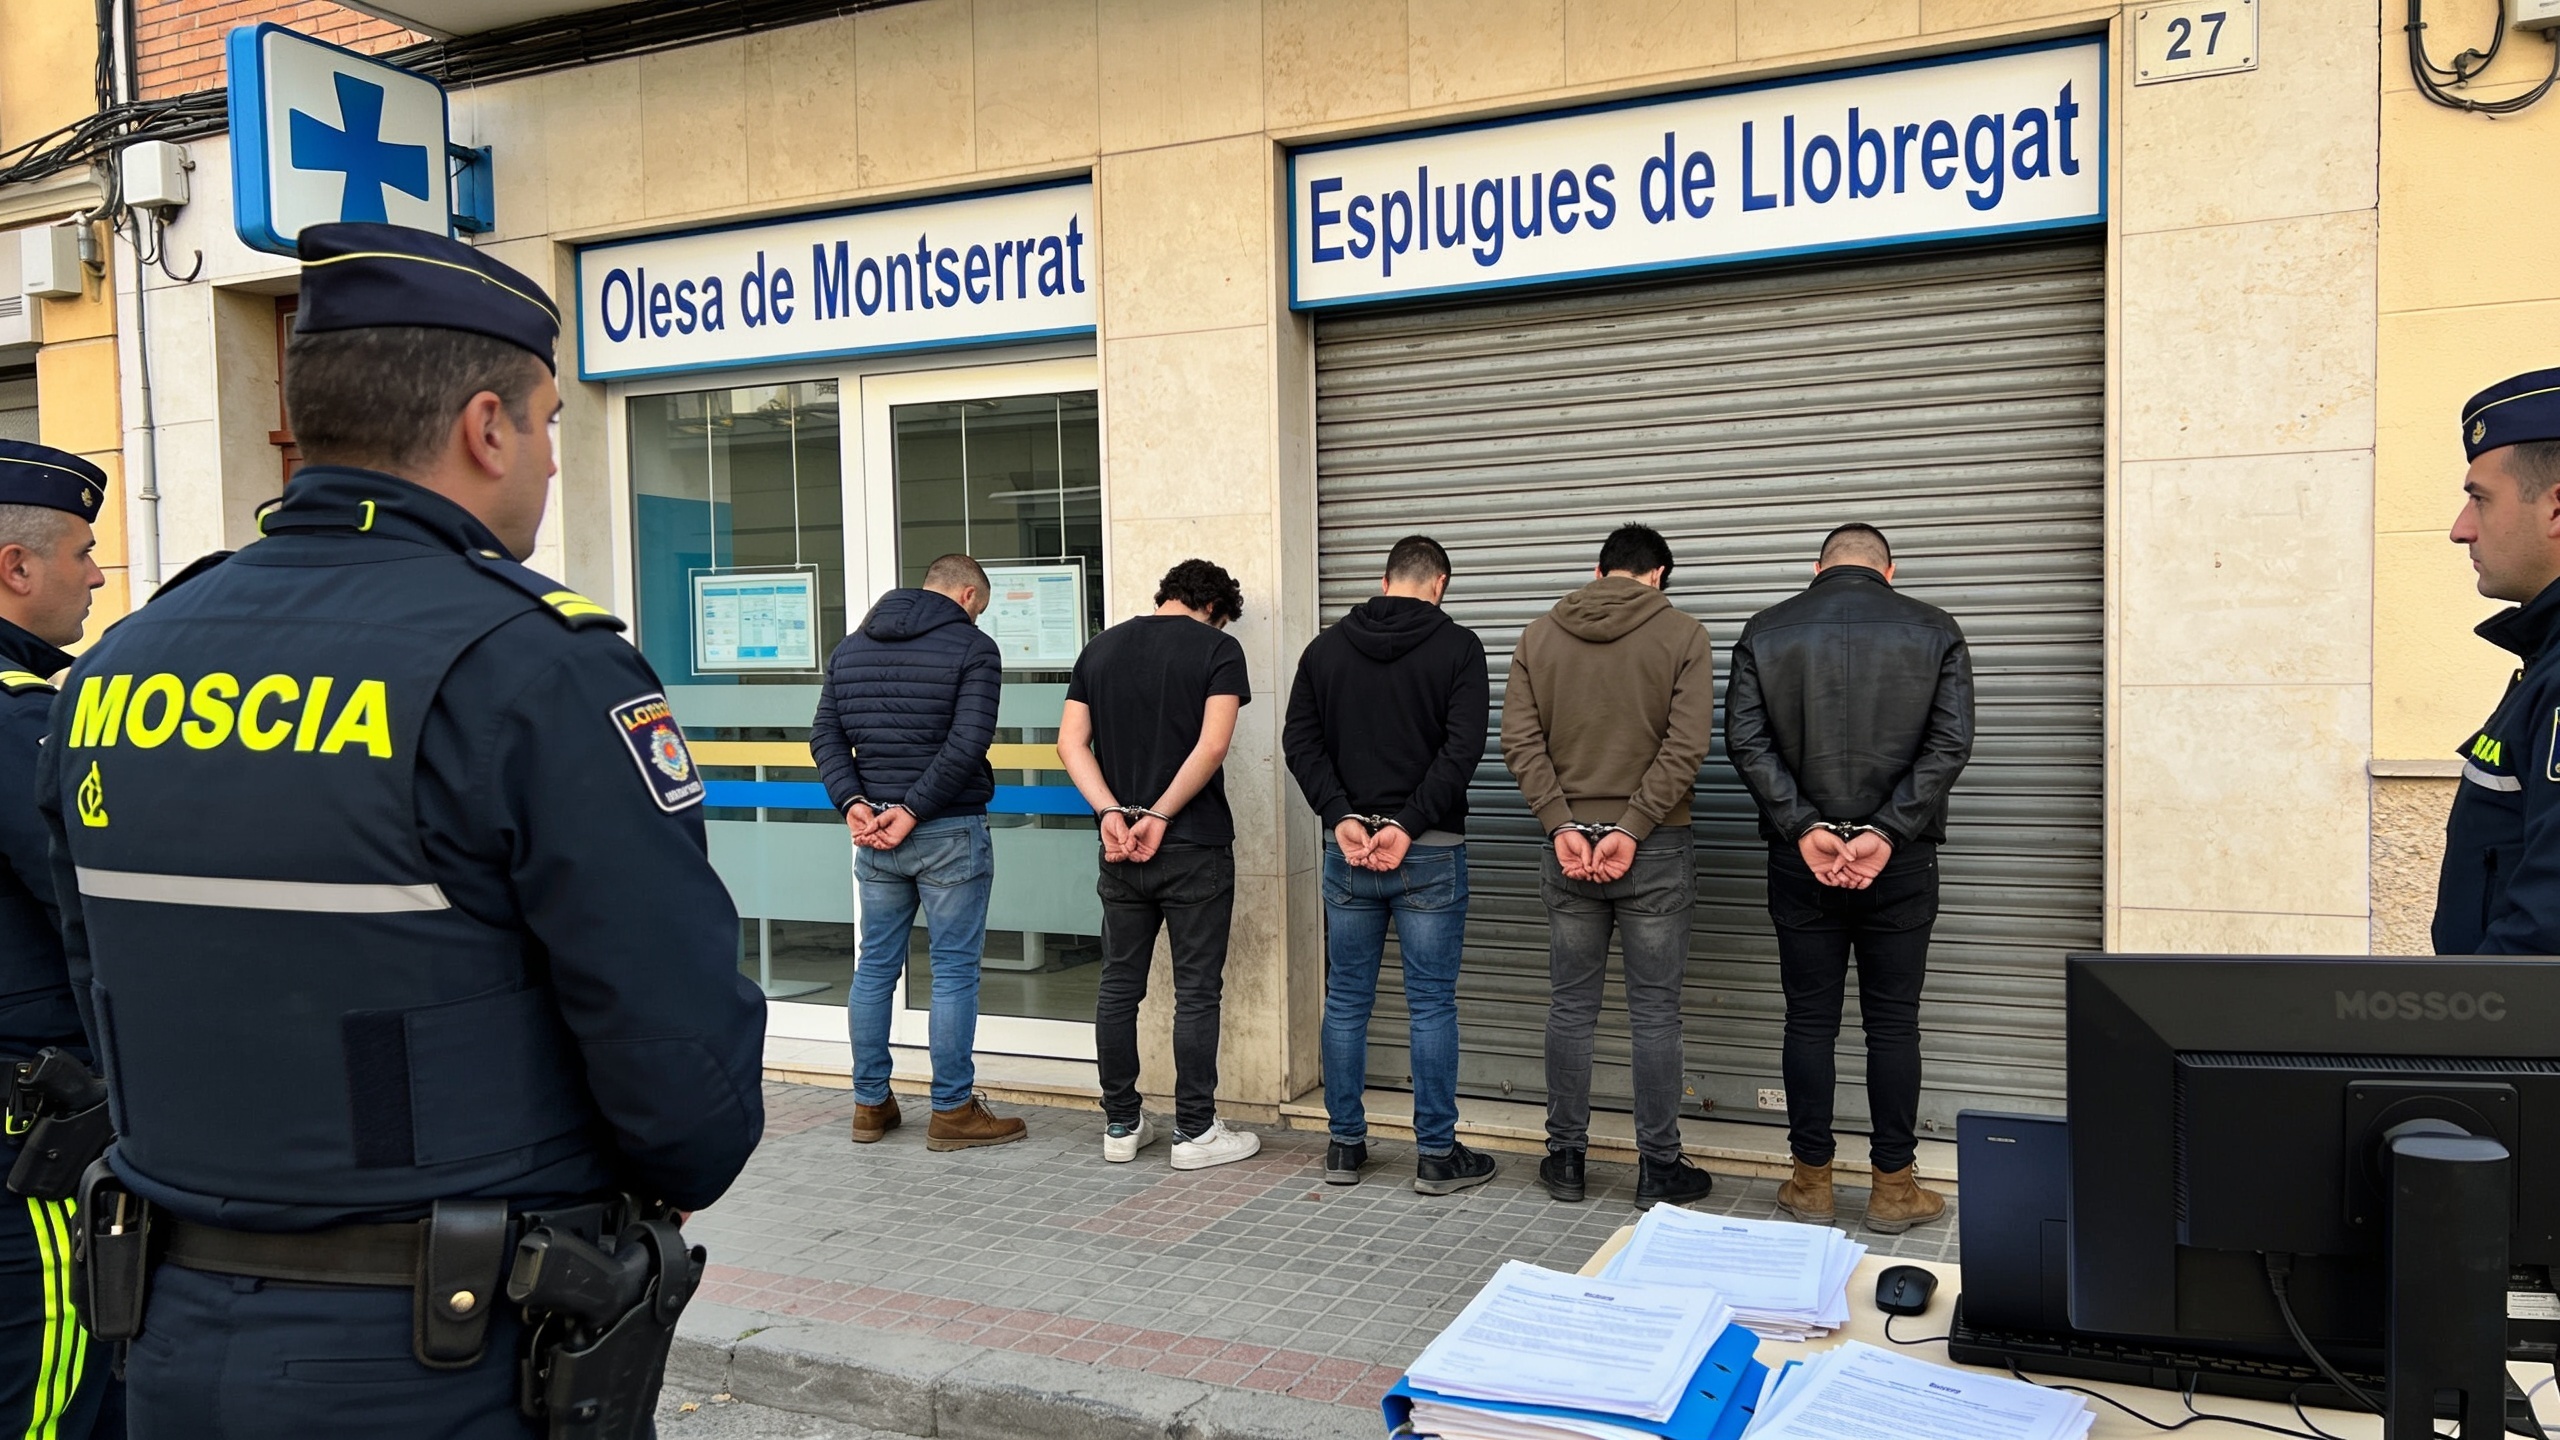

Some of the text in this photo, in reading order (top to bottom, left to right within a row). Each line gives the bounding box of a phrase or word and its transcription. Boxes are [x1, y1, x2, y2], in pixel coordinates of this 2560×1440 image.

[2165, 11, 2228, 61] 27
[1310, 79, 2081, 278] Esplugues de Llobregat
[601, 212, 1085, 344] Olesa de Montserrat
[68, 672, 393, 759] MOSCIA
[2334, 990, 2507, 1022] MOSSOC
